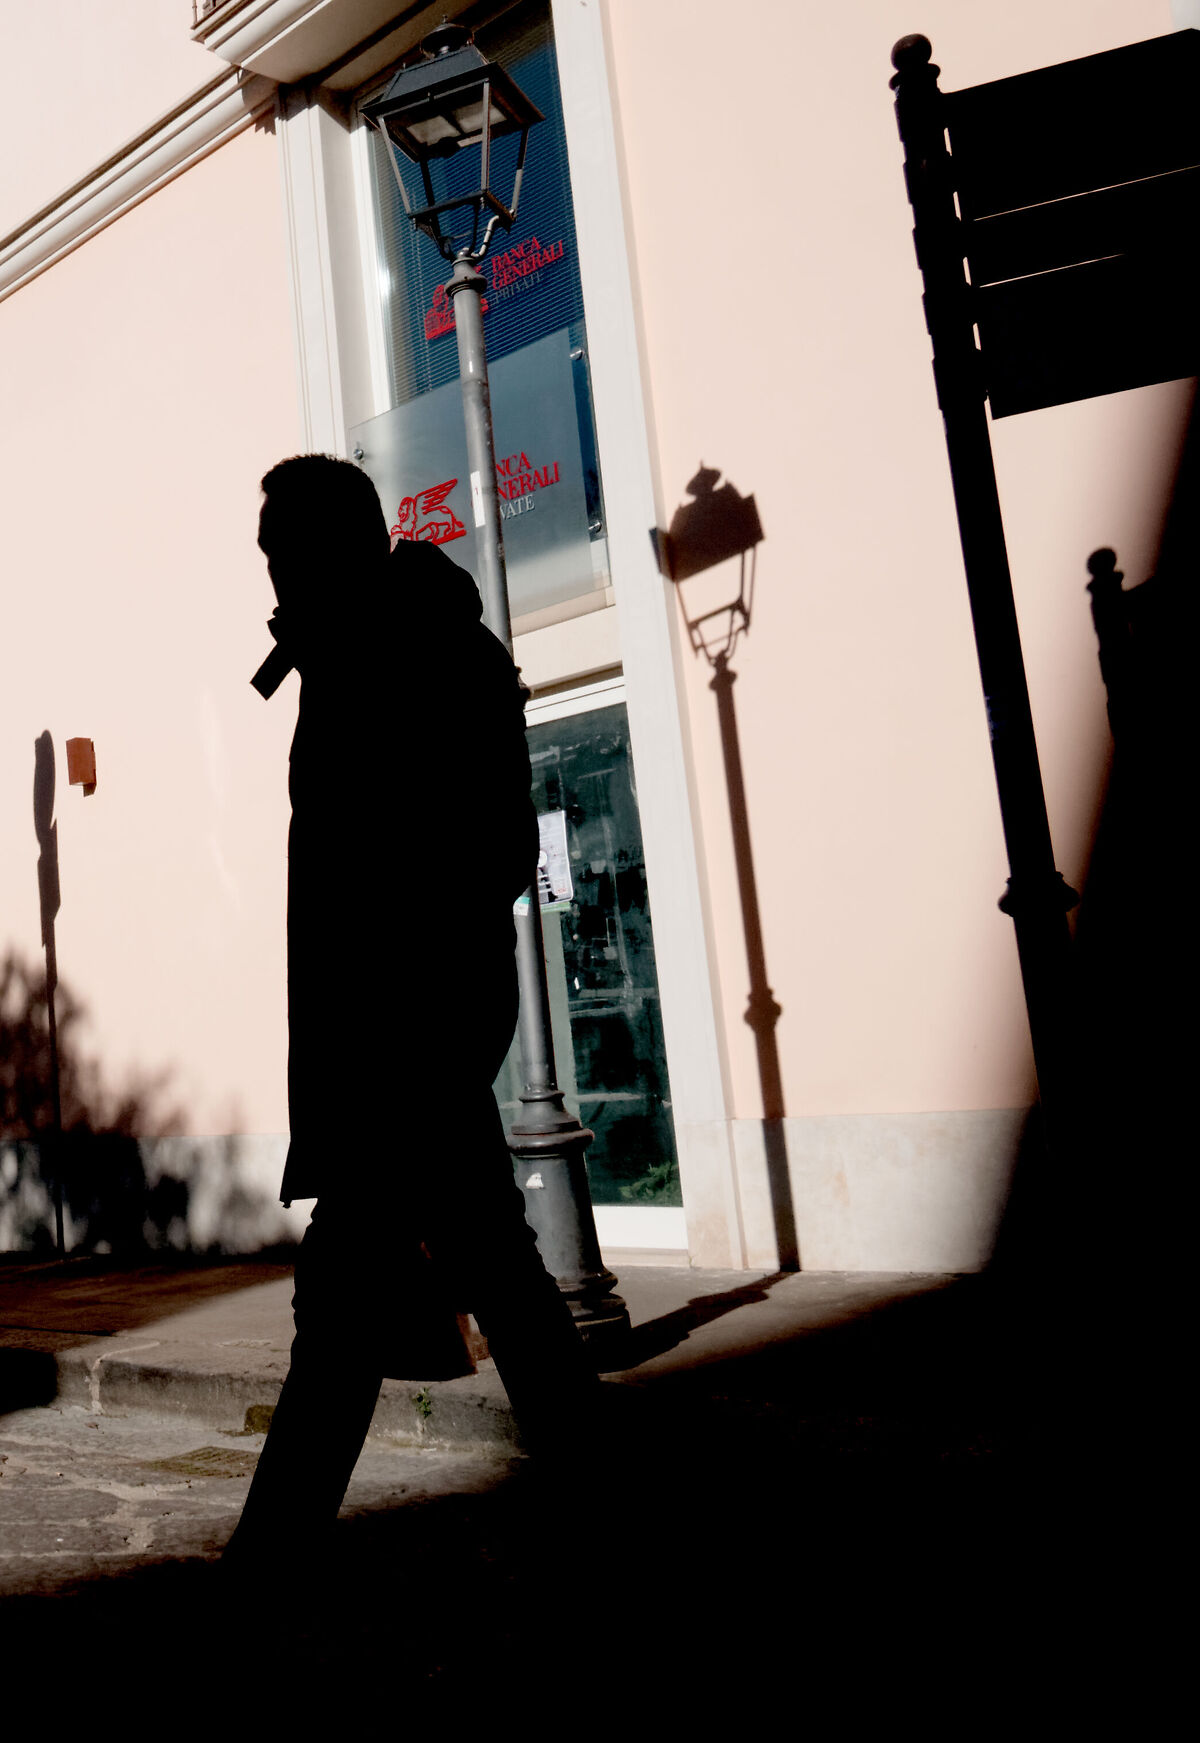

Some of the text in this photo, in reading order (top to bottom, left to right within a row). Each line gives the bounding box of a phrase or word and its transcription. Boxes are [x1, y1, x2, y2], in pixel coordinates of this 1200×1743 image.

[491, 237, 541, 274] BANCA
[492, 240, 565, 291] GENERALI
[496, 452, 532, 477] NCA
[497, 461, 560, 500] NERALI
[500, 495, 535, 520] VATE
